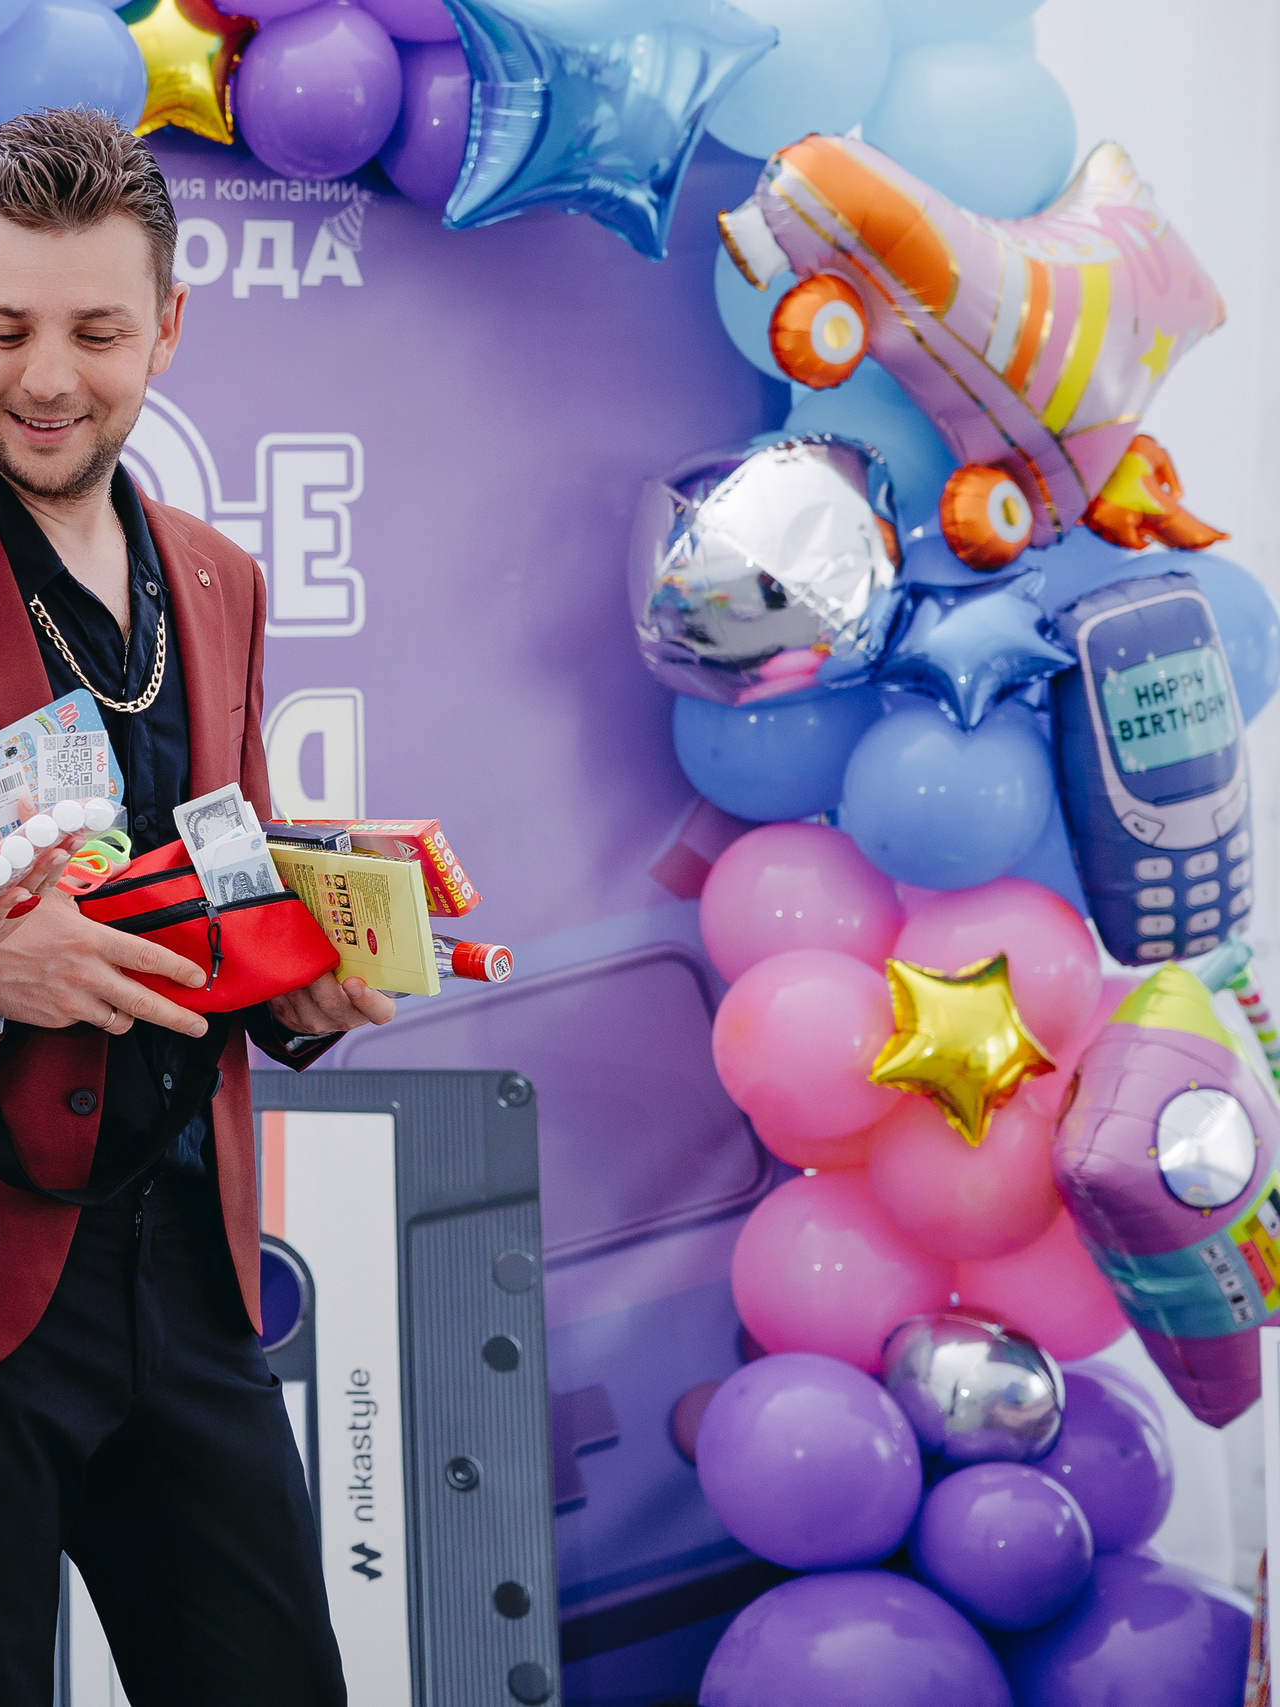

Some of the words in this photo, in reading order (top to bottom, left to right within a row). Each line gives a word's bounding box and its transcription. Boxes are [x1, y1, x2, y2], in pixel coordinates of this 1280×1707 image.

[215, 178, 360, 202] компании
[1134, 669, 1205, 707] HAPPY
[1119, 693, 1226, 741] BIRTHDAY
[96, 751, 107, 773] wb
[423, 836, 447, 872] GAME
[442, 873, 467, 909] BRICK
[346, 1368, 378, 1522] nikastyle
